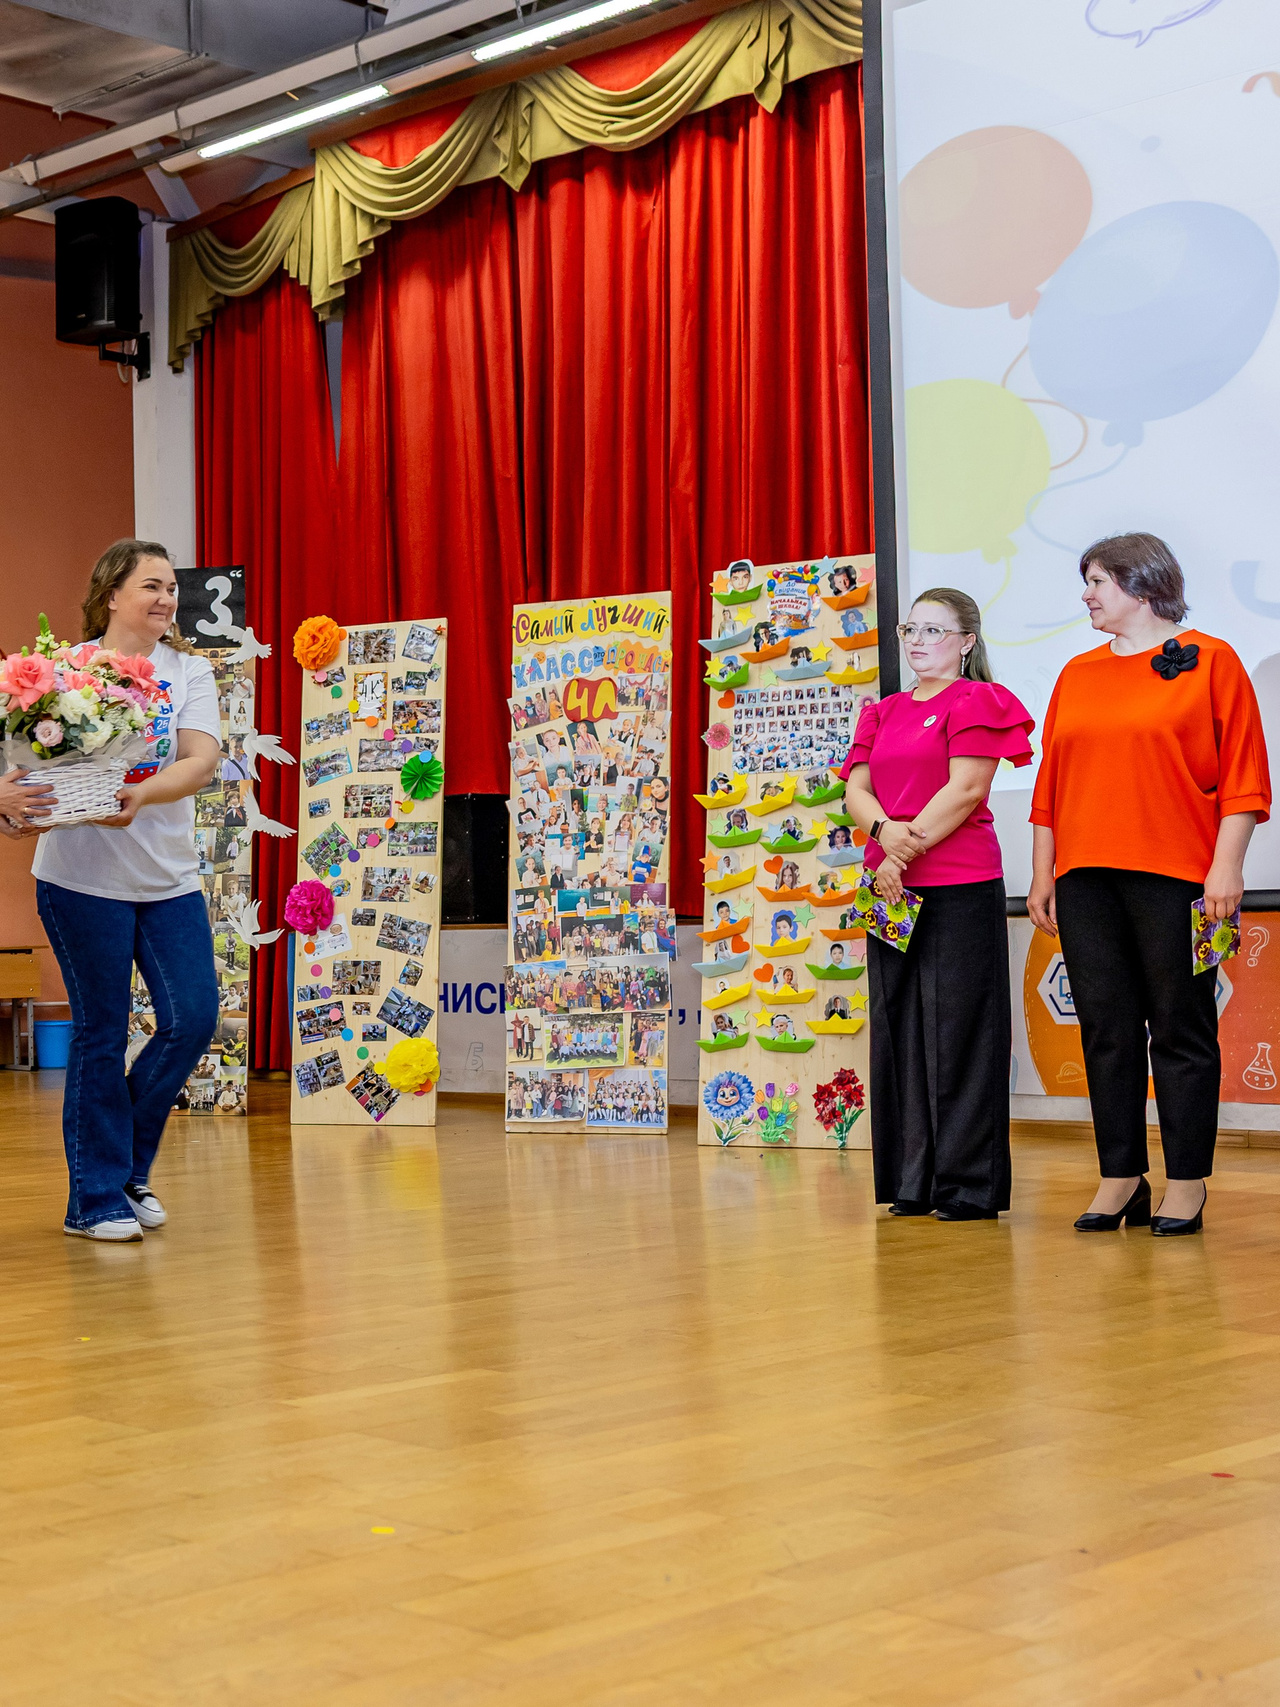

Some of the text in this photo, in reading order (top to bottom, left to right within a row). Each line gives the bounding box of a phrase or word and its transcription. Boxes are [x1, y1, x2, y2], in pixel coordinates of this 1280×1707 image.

[513, 645, 593, 689] КЛАСС
[606, 646, 634, 669] ПРО
[156, 719, 169, 730] 25
